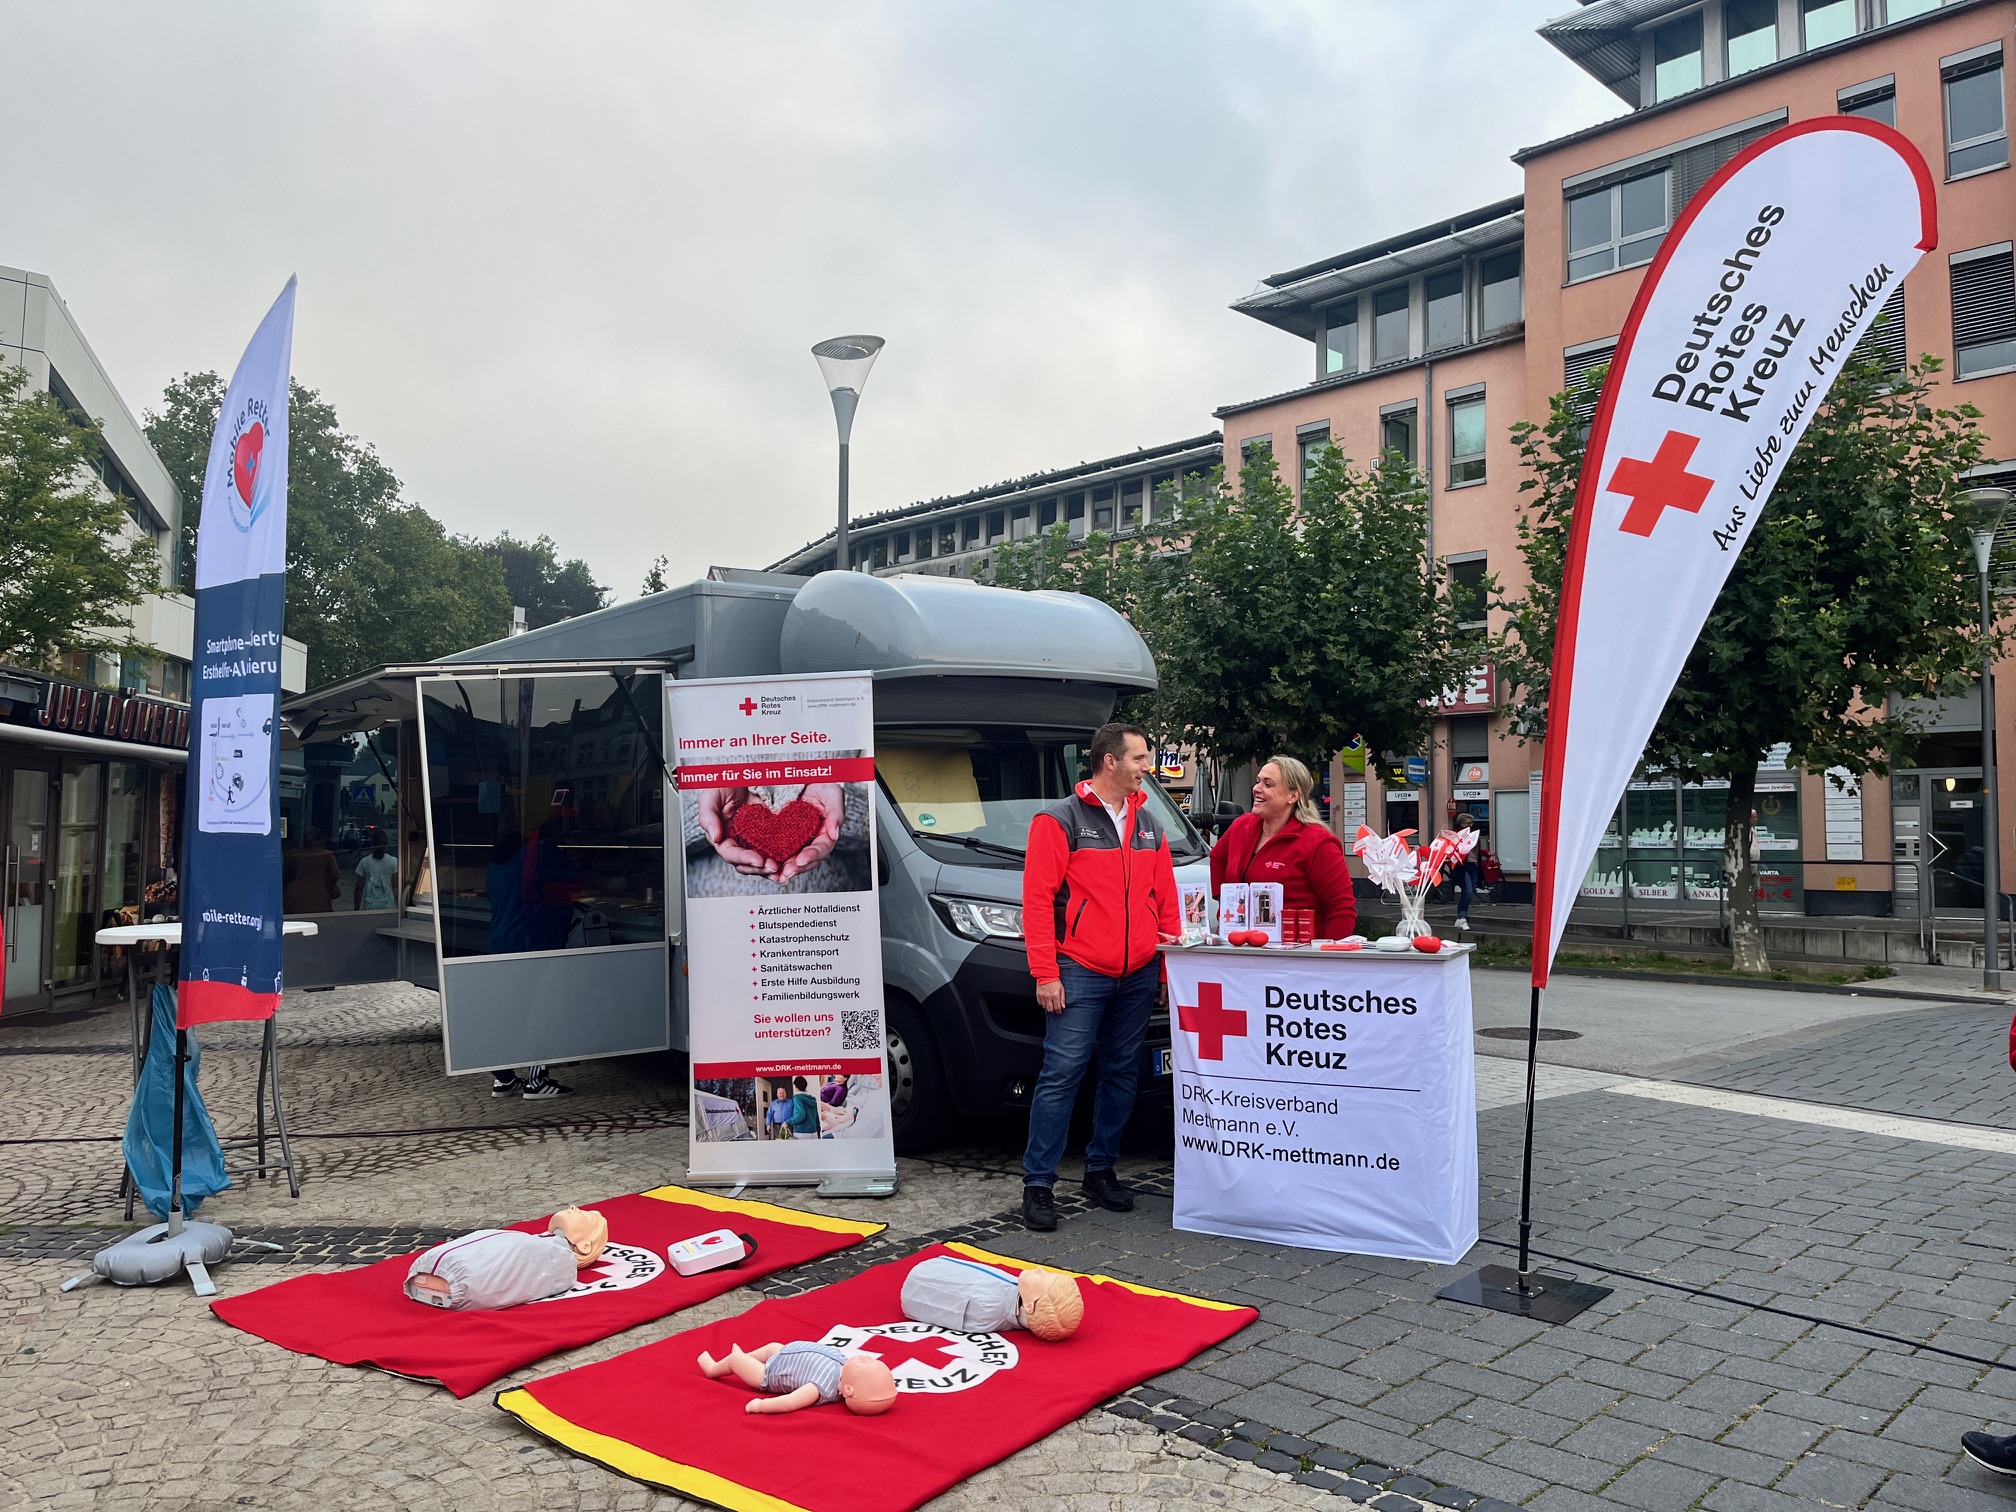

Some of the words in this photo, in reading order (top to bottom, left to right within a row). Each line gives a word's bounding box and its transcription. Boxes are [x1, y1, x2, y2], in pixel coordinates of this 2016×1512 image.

[1652, 205, 1785, 403] Deutsches
[1685, 303, 1768, 412] Rotes
[1720, 313, 1806, 423] Kreuz
[1712, 505, 1747, 551] Aus
[1739, 435, 1782, 501] Liebe
[1780, 380, 1817, 435] zum
[1808, 263, 1895, 375] Menschen
[226, 410, 246, 488] Mobile
[760, 695, 797, 703] Deutsches
[103, 686, 190, 748] DÖNERH
[678, 736, 725, 750] Immer
[729, 736, 748, 747] an
[752, 733, 787, 746] Ihrer
[790, 731, 832, 745] Seite.
[680, 771, 719, 783] Immer
[721, 770, 740, 781] für
[742, 769, 763, 780] Sie
[765, 768, 781, 779] im
[784, 765, 832, 778] Einsatz!
[1468, 768, 1481, 777] ria
[1462, 790, 1477, 798] Lyca
[1688, 841, 1725, 849] Trauringstud
[1583, 888, 1606, 896] GOLD
[1638, 889, 1669, 897] SILBER
[758, 905, 802, 916] Ärztlicher
[804, 904, 861, 914] Notfalldienst
[758, 919, 837, 930] Blutspendedienst
[759, 934, 850, 944] Katastrophenschutz
[760, 948, 840, 958] Krankentransport
[760, 962, 833, 973] Sanitätswachen
[761, 978, 785, 987] Erste
[787, 977, 808, 986] Hilfe
[810, 976, 861, 986] Ausbildung
[762, 991, 860, 1001] Familienbildungswerk
[1264, 985, 1418, 1016] Deutsches
[753, 1014, 771, 1025] Sie
[774, 1012, 811, 1023] wollen
[813, 1013, 835, 1022] uns
[754, 1026, 832, 1039] unterstützen?
[1265, 1014, 1347, 1041] Rotes
[1265, 1042, 1348, 1071] Kreuz
[755, 1063, 842, 1073] www.DRK-mettmann.de
[1181, 1083, 1338, 1115] DRK-Kreisverband
[1182, 1107, 1260, 1135] Mettmann
[1265, 1120, 1300, 1137] e.V.
[1181, 1134, 1400, 1171] www.DRK-mettmann.de
